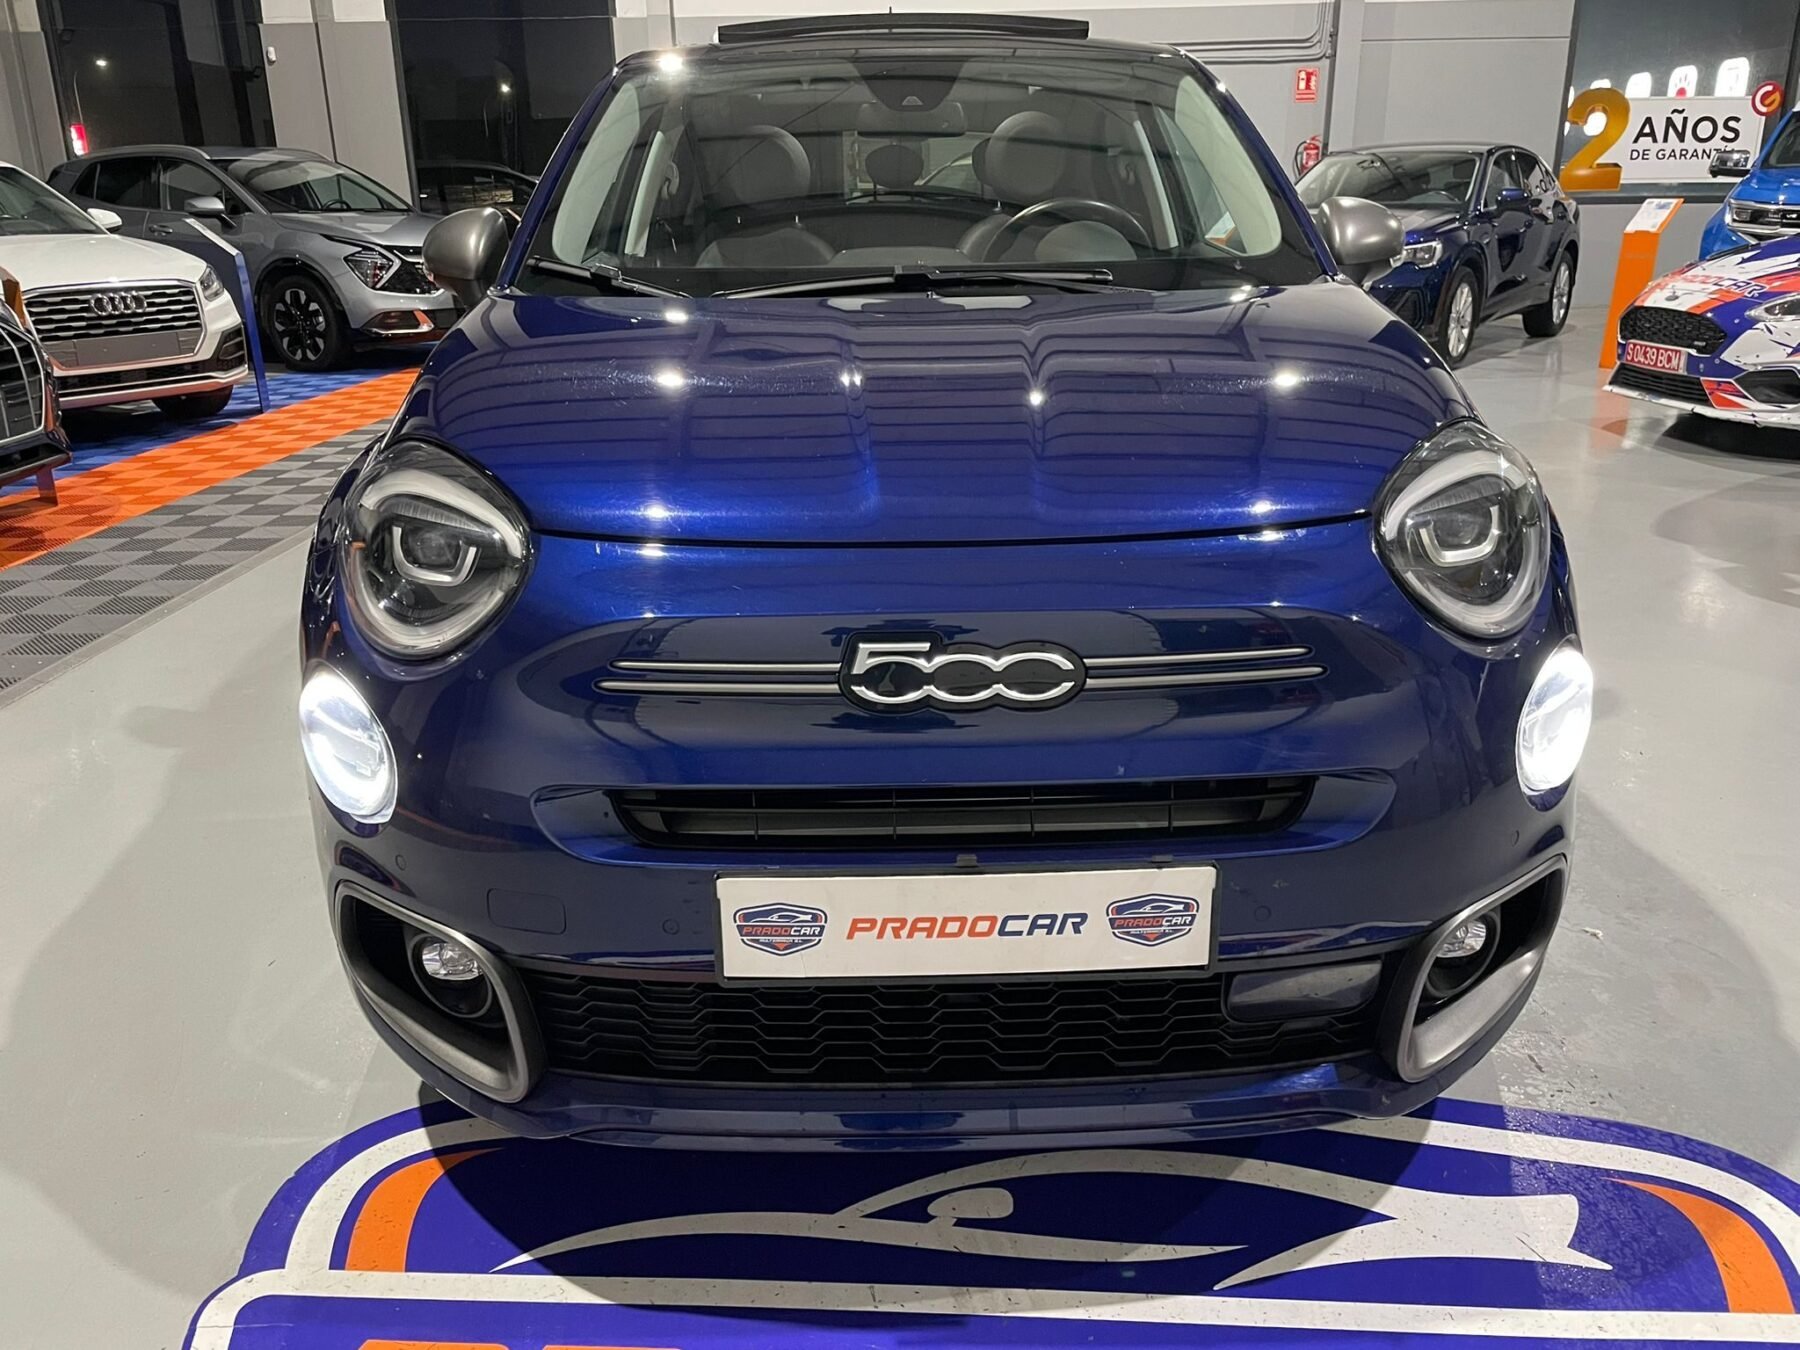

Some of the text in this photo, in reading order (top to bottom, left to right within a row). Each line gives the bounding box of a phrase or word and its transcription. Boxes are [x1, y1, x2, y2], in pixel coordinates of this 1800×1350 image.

[1559, 87, 1742, 192] 2 AÑOS
[1629, 145, 1738, 161] DE GARAN
[1626, 343, 1680, 371] S 0439 BCM
[850, 642, 1075, 704] 500
[742, 926, 821, 936] PRADOCAR
[846, 912, 1089, 940] PRADOCAR
[1113, 916, 1192, 928] PRADOCAR
